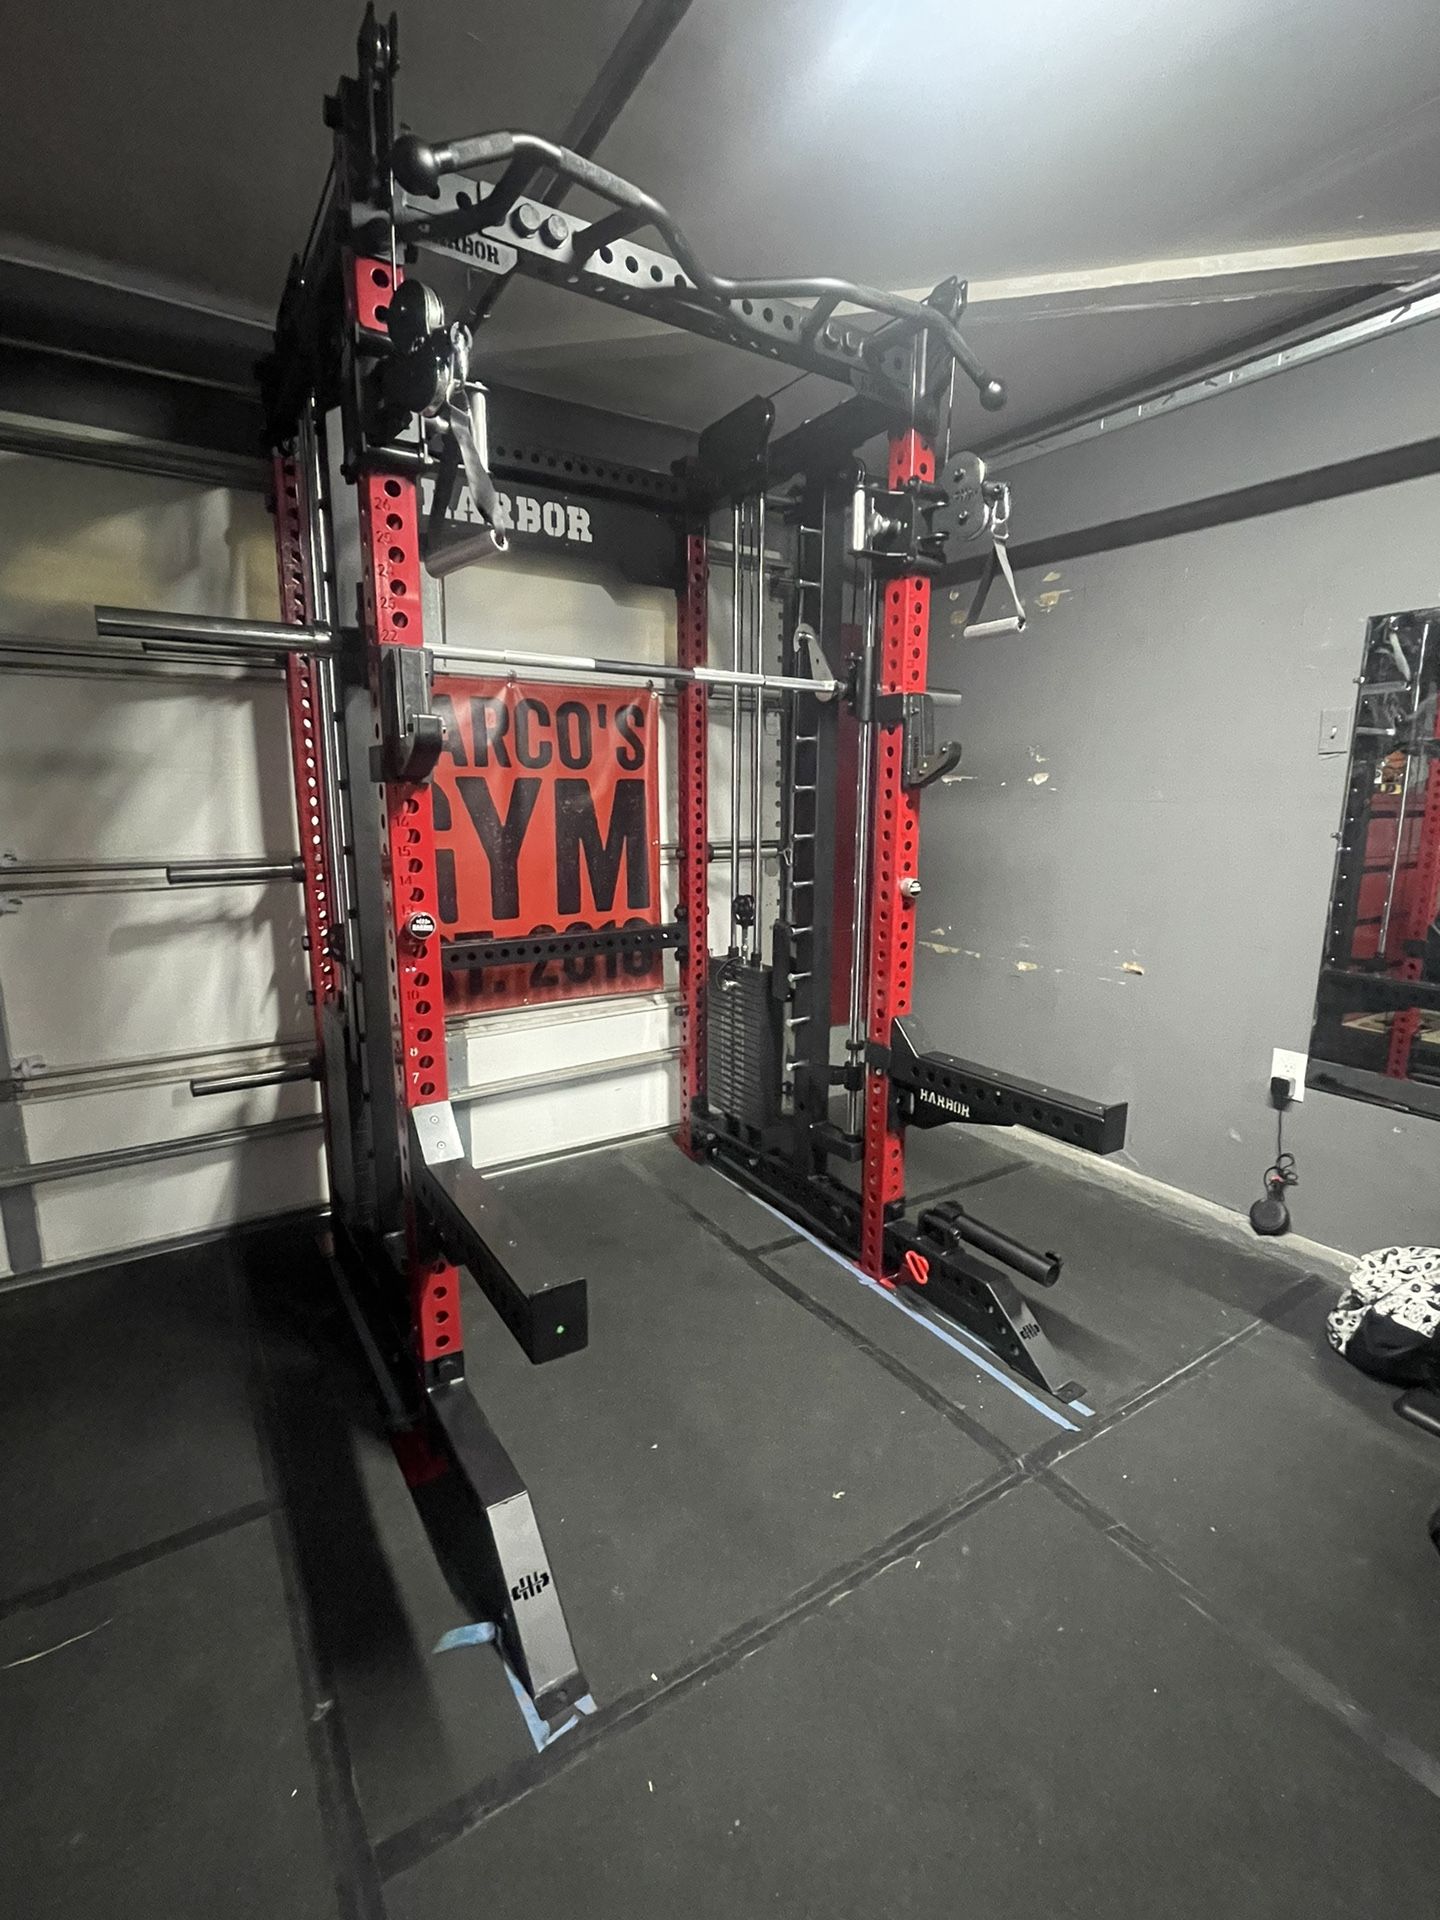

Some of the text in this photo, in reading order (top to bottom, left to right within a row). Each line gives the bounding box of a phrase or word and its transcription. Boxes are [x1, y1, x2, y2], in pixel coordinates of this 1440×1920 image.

[382, 630, 399, 643] 22
[432, 694, 646, 771] ARCO'S
[397, 846, 411, 858] 15
[412, 1071, 421, 1084] 7
